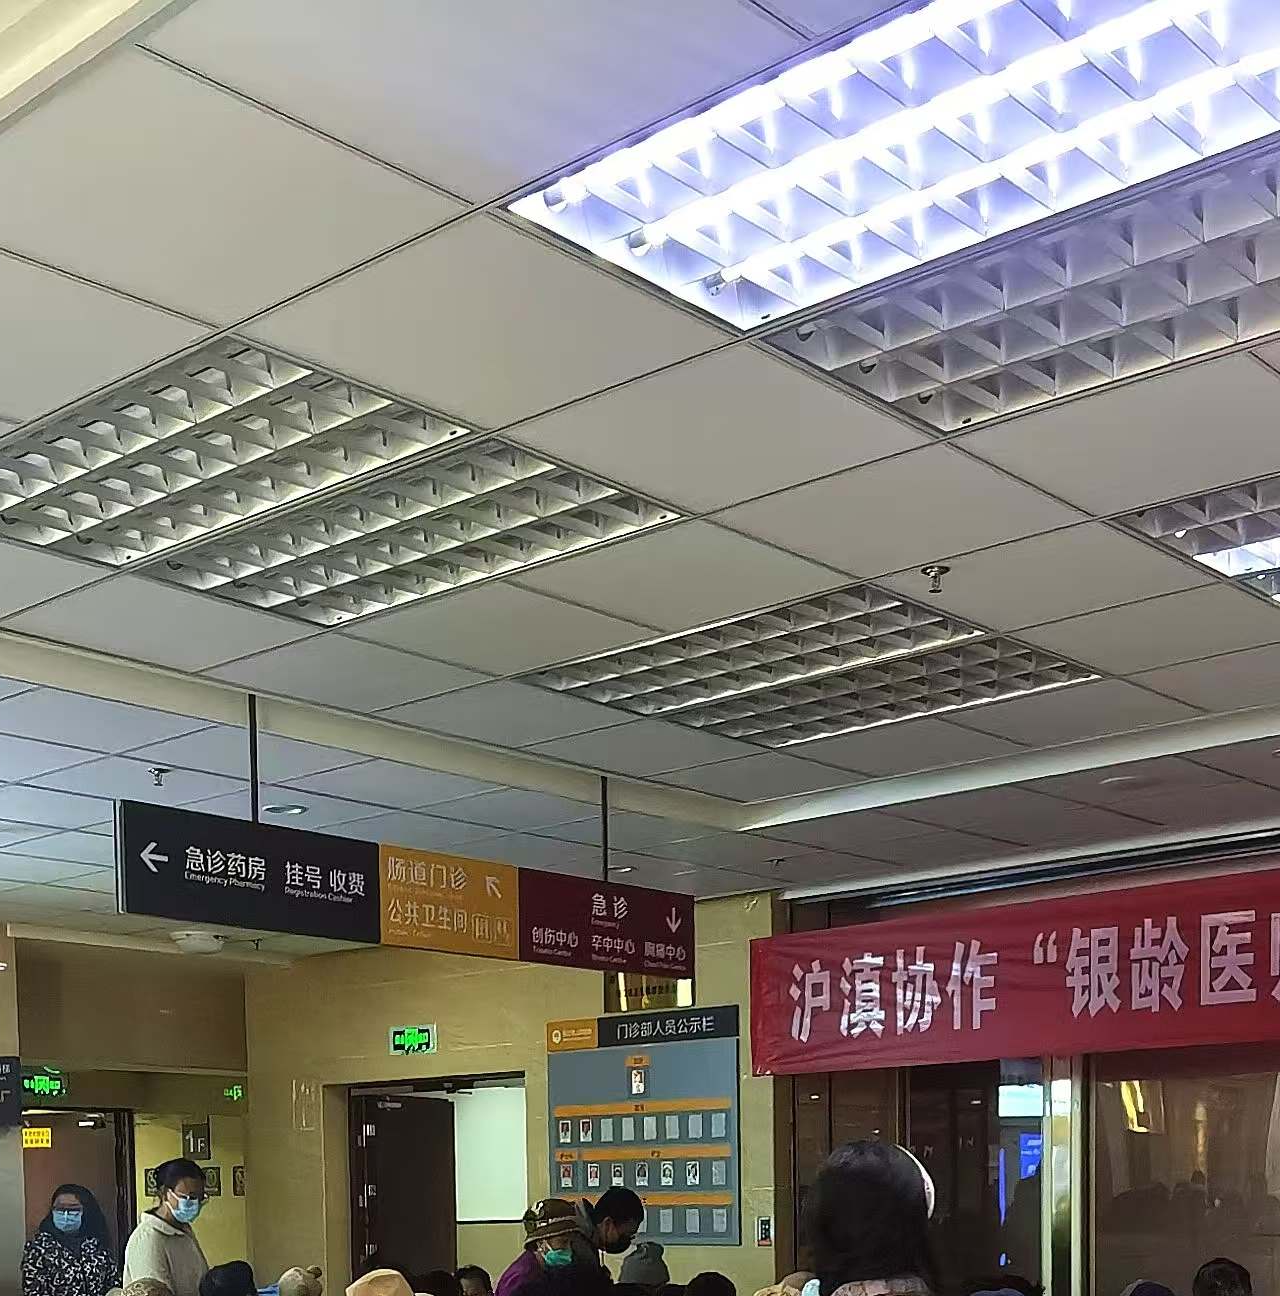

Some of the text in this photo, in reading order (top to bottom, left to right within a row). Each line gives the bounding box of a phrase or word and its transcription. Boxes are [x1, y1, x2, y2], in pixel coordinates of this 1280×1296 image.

[184, 845, 267, 881] 急诊药房
[387, 855, 468, 891] 肠道门诊
[184, 870, 228, 888] Emergency
[284, 860, 323, 890] 挂号
[328, 868, 366, 897] 收费
[387, 897, 468, 934] 公共卫生间
[591, 892, 629, 919] 急诊
[532, 926, 579, 948] 创伤中心
[591, 934, 636, 955] 卒中中心
[789, 939, 998, 1043] 沪滇协作
[616, 1015, 715, 1041] 门诊部人员公示栏
[185, 1129, 205, 1153] 1F
